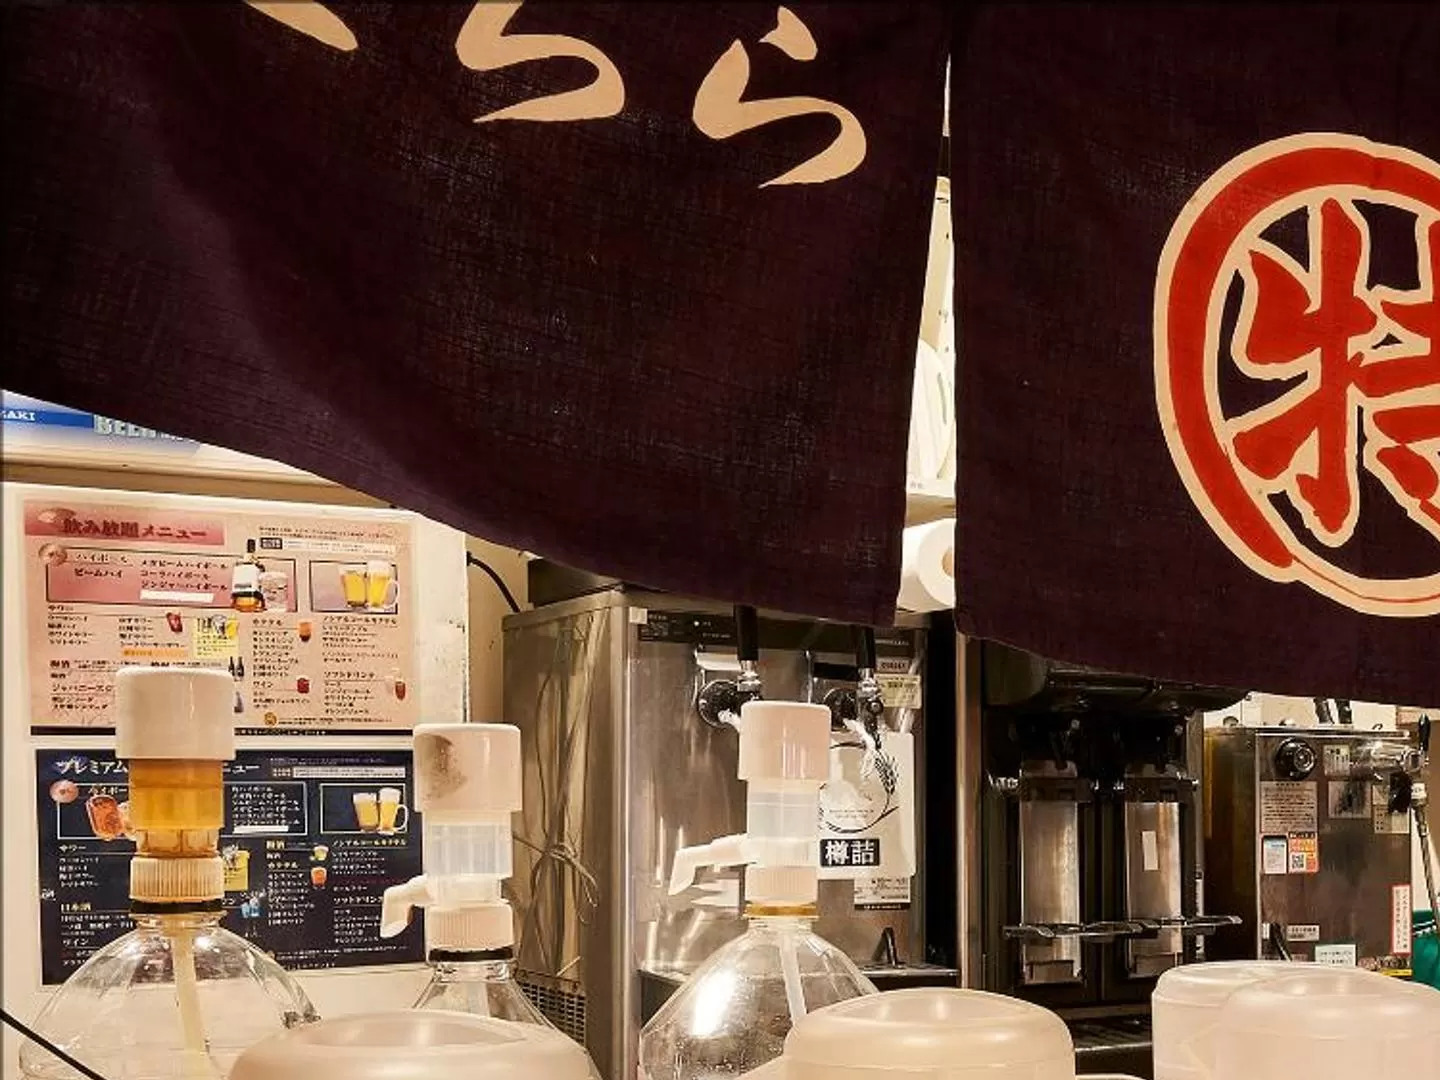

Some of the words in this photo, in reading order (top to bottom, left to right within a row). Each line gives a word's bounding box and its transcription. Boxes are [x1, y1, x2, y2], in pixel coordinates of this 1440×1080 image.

[243, 0, 867, 189] ちら
[62, 517, 208, 539] 飲み放題メニュー
[87, 785, 128, 796] ハイボー
[824, 839, 876, 865] 樽詰
